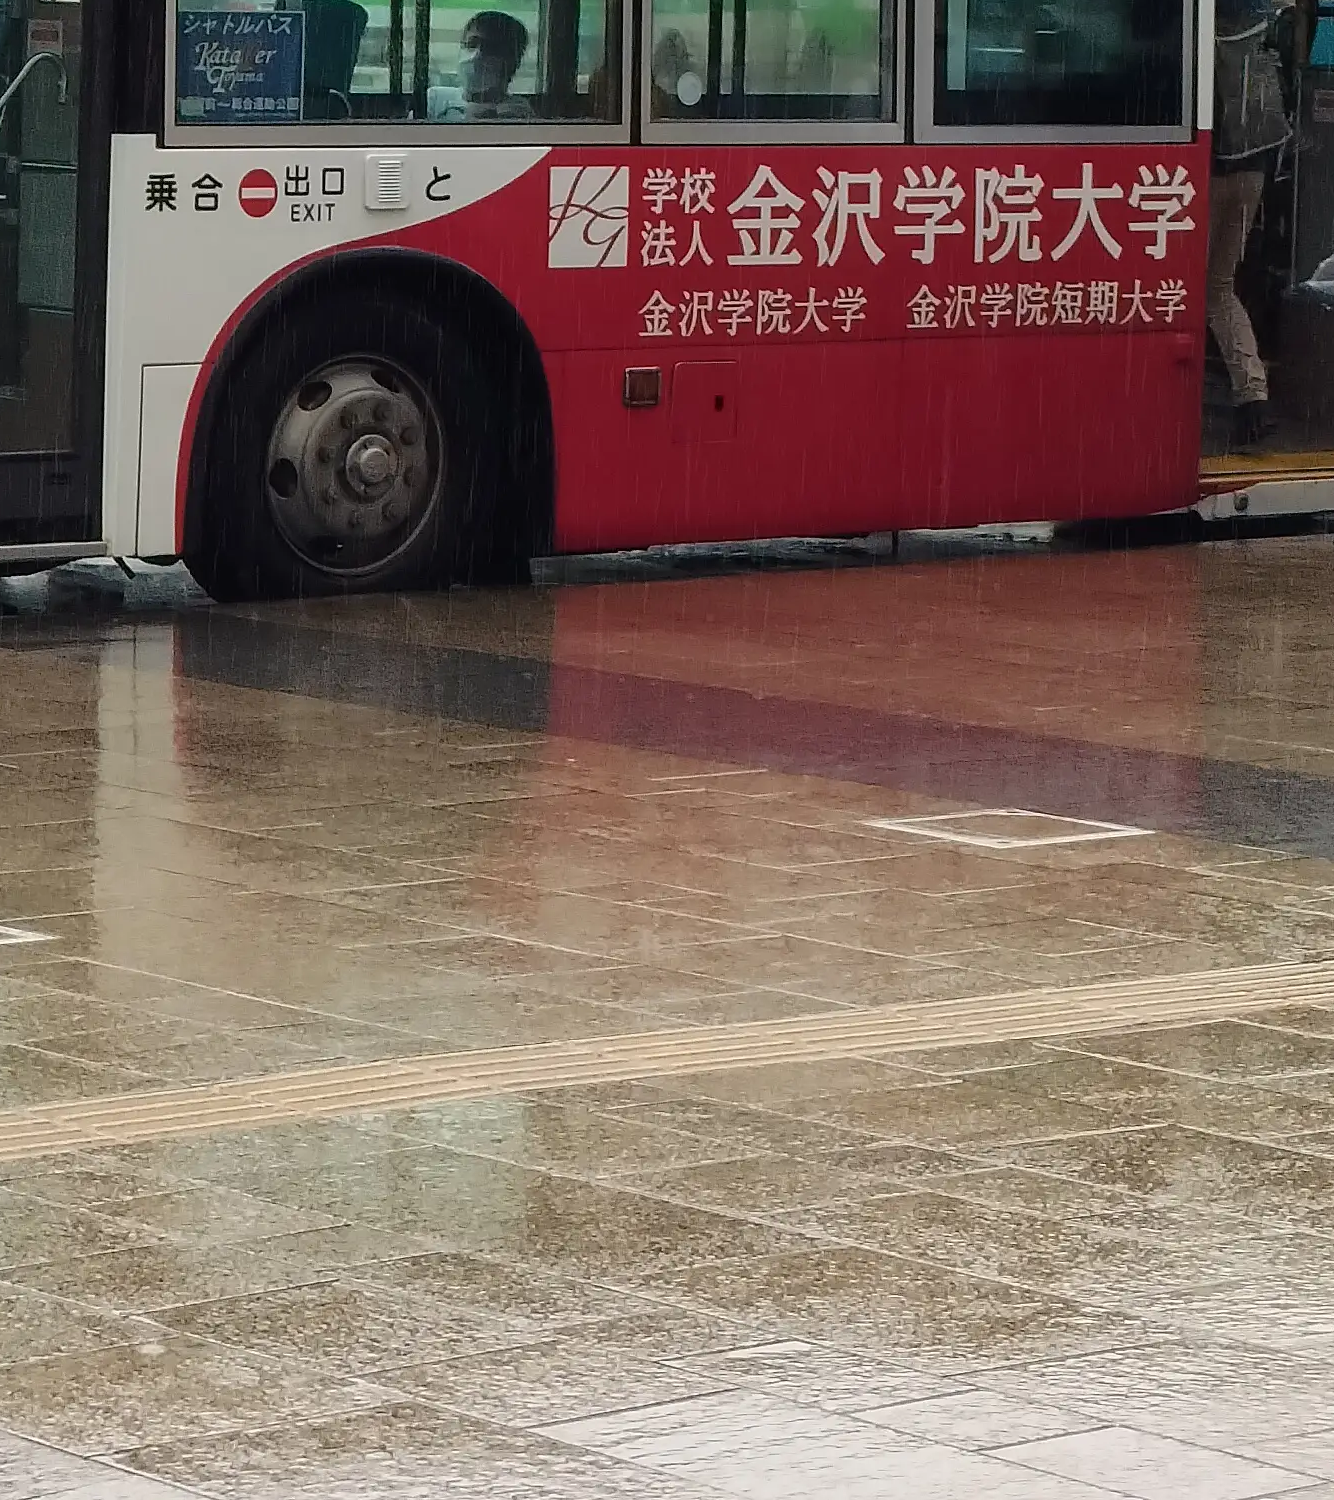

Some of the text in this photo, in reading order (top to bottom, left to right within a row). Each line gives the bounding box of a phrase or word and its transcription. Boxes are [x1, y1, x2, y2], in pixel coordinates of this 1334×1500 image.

[183, 13, 293, 35] シャトルバス
[194, 41, 277, 71] Kataer
[145, 164, 451, 211] 乗合 出口 と
[642, 167, 716, 214] 学校
[290, 203, 336, 222] EXIT
[726, 162, 1197, 267] 金沢学院大学
[640, 220, 714, 267] 法人
[638, 278, 1187, 337] 金沢学院大学 金沢学院短期大学
